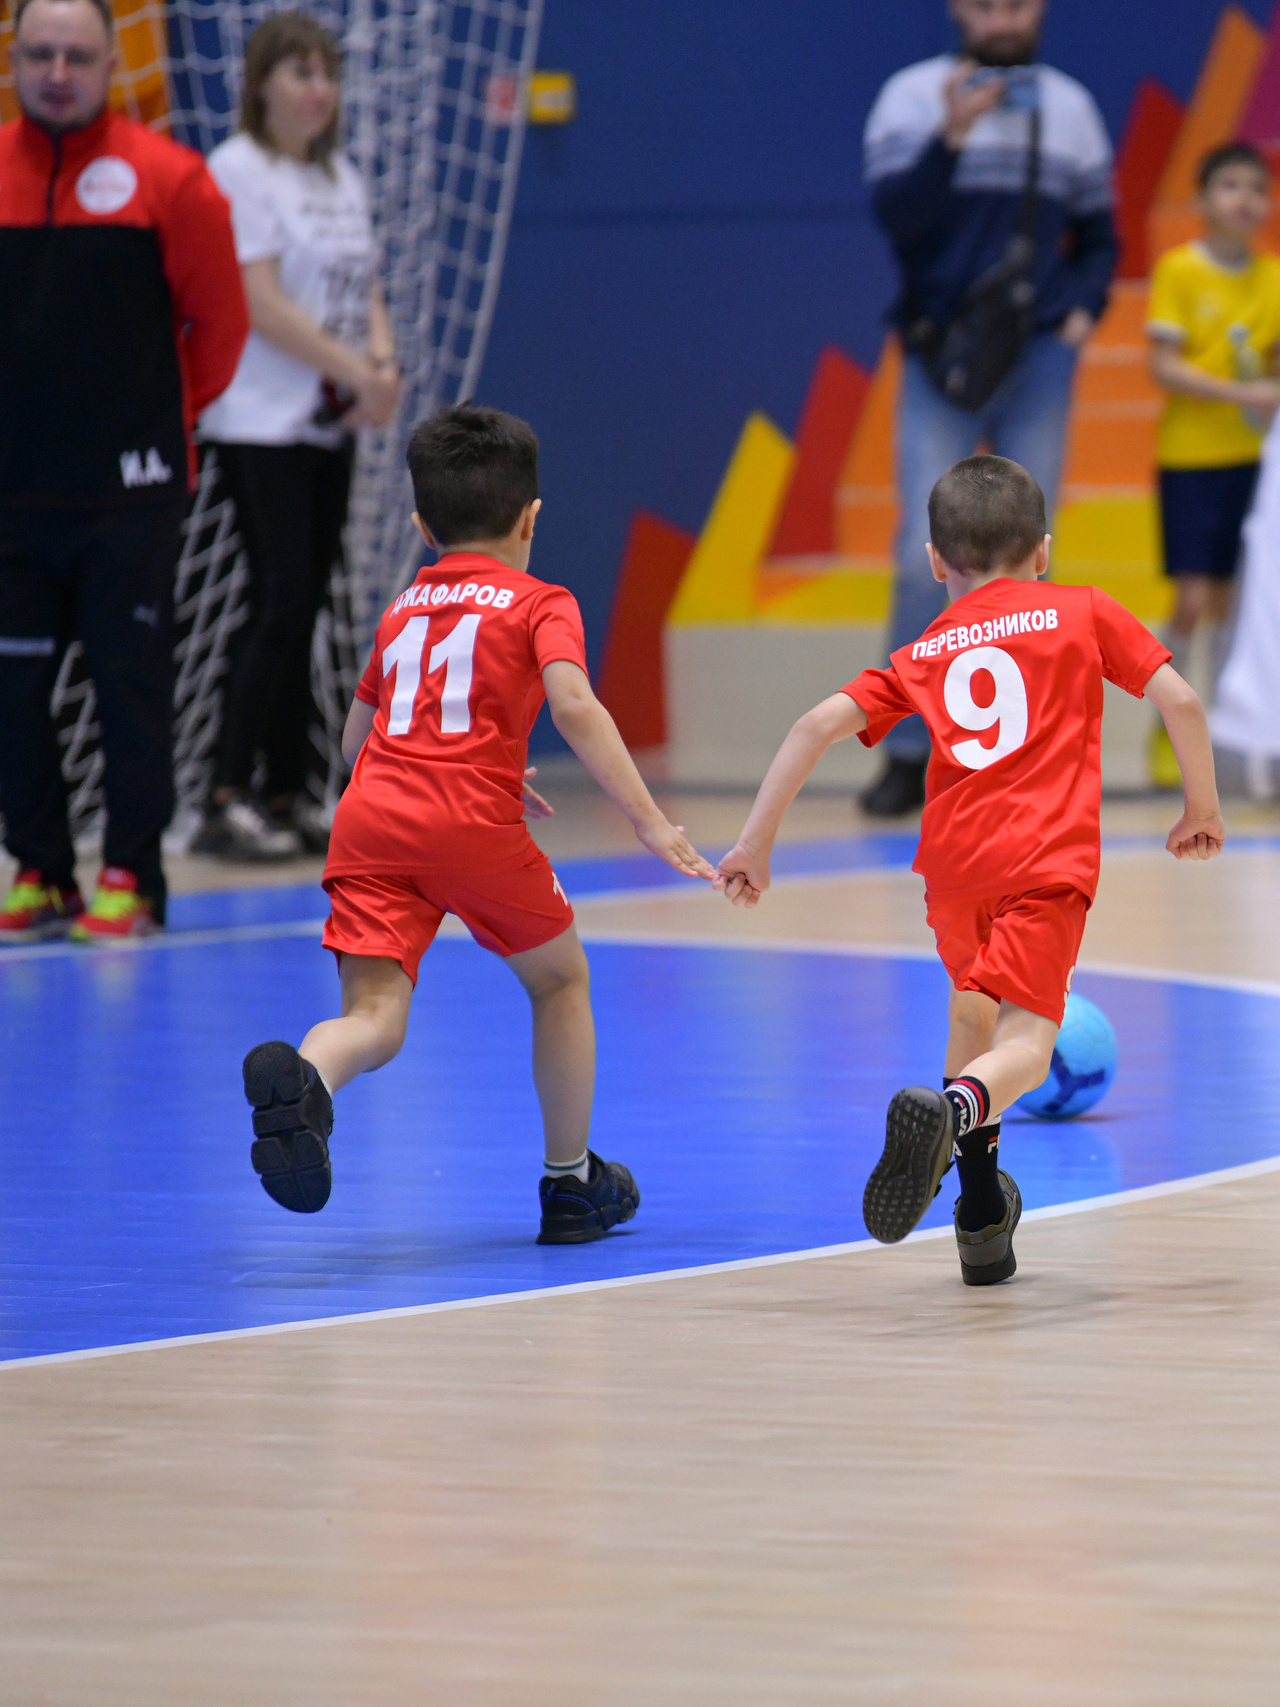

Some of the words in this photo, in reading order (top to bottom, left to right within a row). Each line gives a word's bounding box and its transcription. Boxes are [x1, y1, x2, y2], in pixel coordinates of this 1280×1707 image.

[383, 614, 482, 736] 11
[912, 608, 1058, 660] ПЕРЕВОЗНИКОВ
[943, 646, 1028, 770] 9
